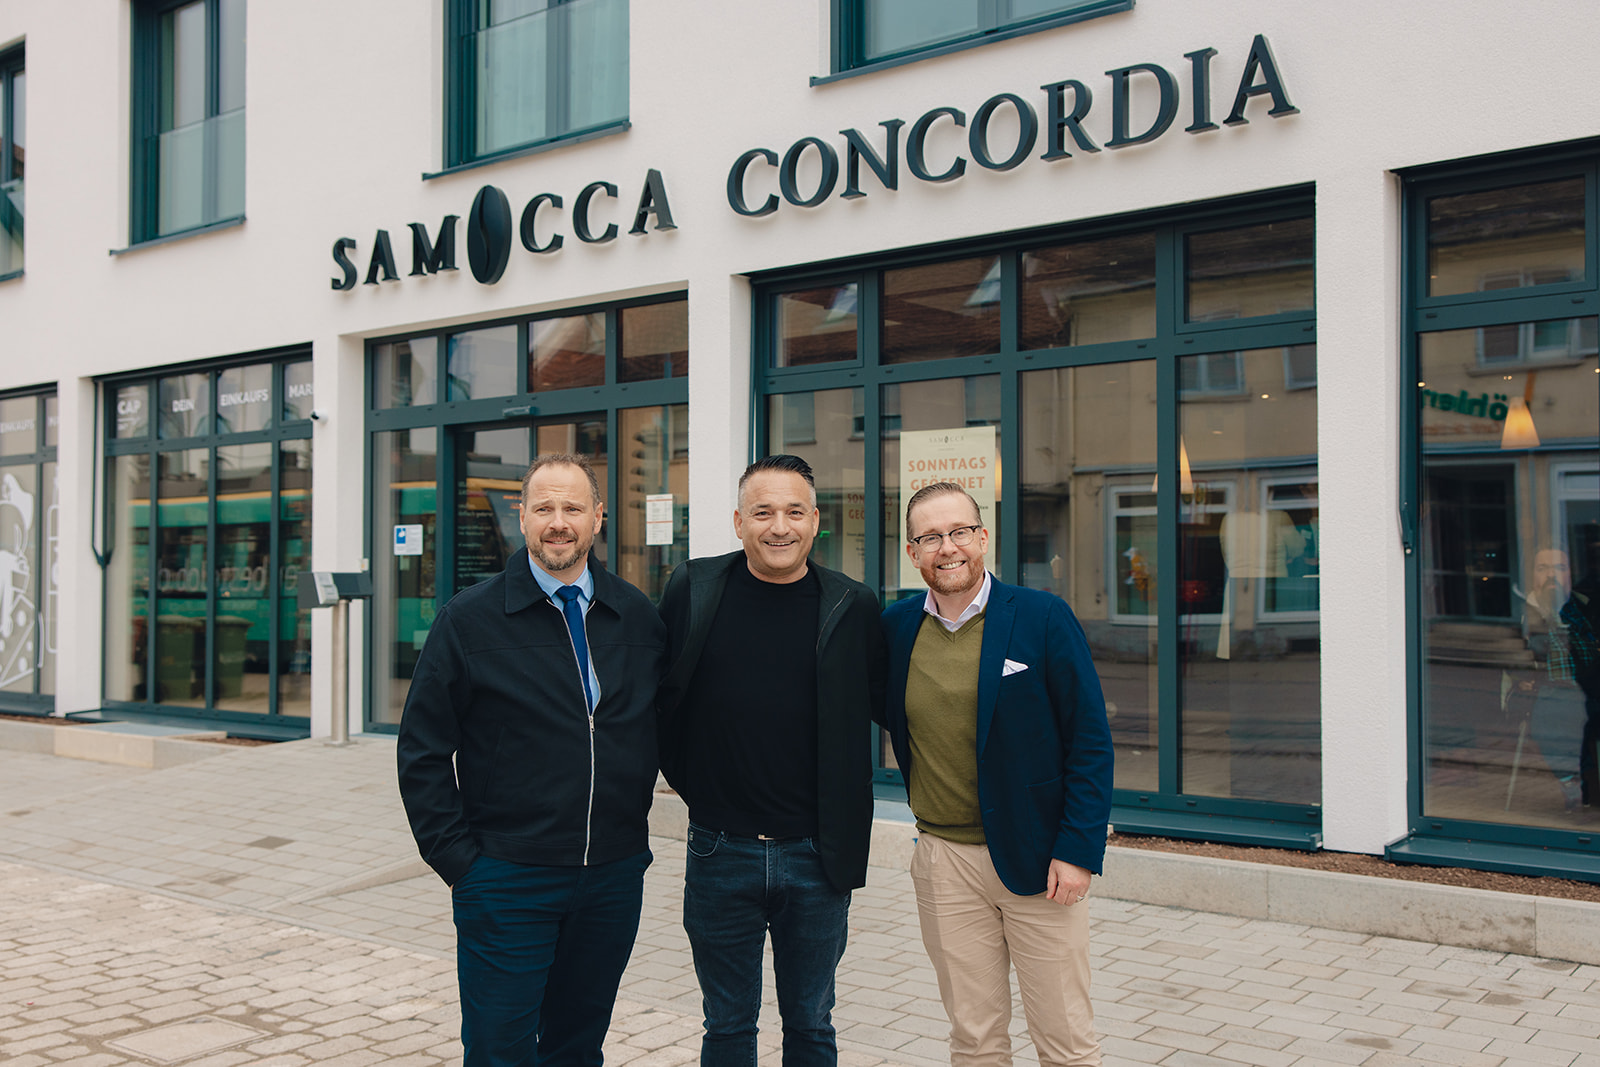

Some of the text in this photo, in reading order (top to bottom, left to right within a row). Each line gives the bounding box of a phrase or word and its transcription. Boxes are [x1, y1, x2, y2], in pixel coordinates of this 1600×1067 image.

[726, 33, 1301, 218] CONCORDIA
[117, 399, 142, 415] CAP
[172, 398, 195, 413] DEIN
[220, 389, 269, 407] EINKAUFS
[908, 456, 987, 473] SONNTAGS
